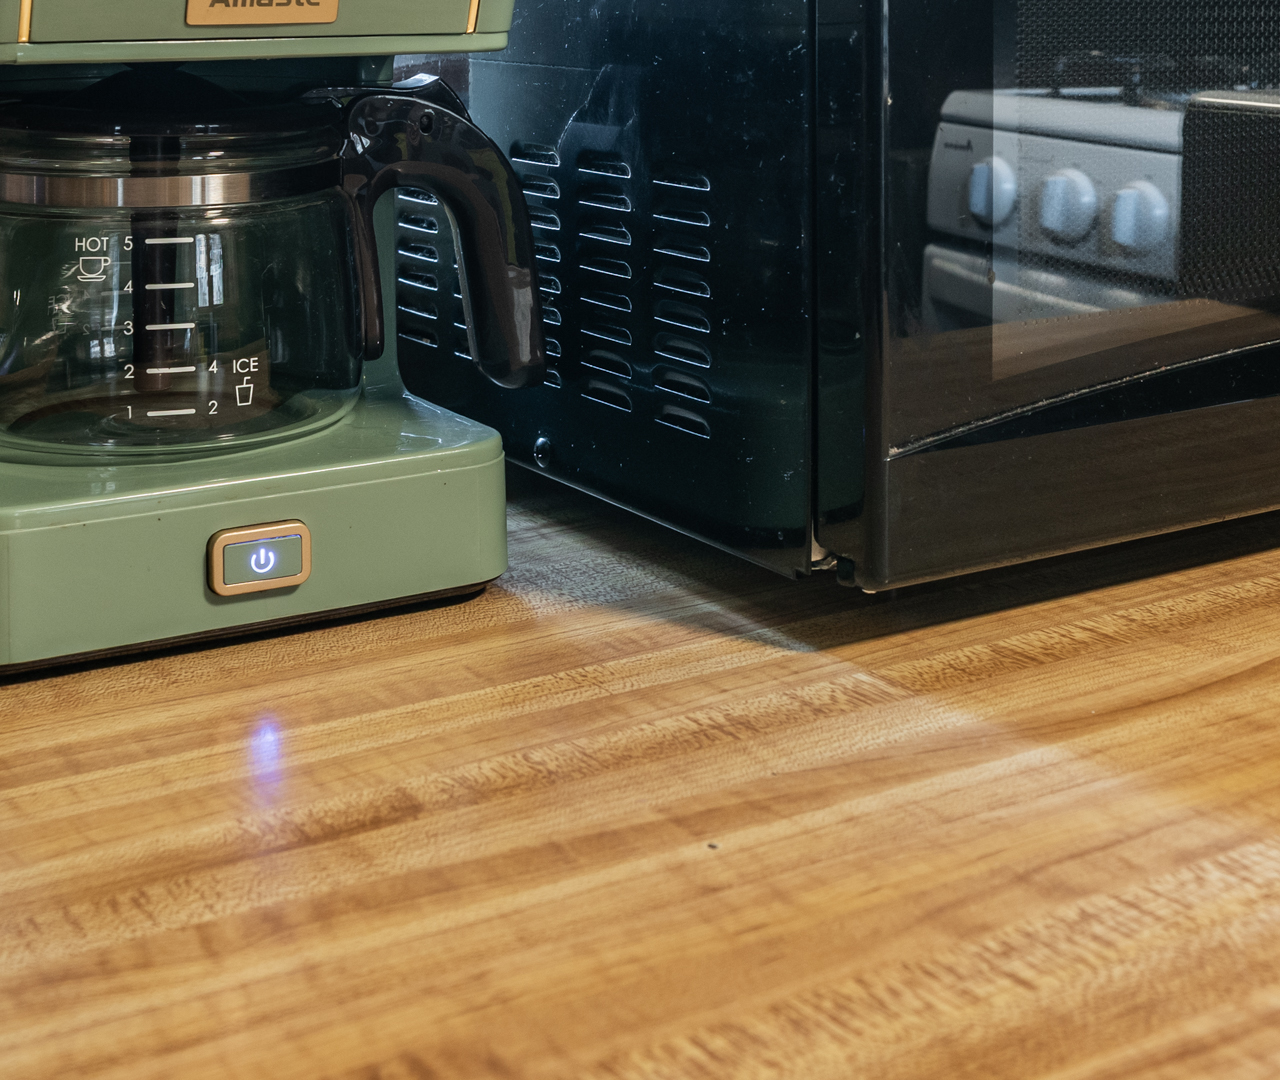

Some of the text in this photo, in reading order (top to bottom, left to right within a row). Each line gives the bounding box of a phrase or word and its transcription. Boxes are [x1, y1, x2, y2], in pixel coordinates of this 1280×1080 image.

[75, 237, 109, 251] HOT
[123, 236, 133, 250] 5
[123, 280, 133, 293] 4
[123, 321, 134, 335] 3
[124, 364, 134, 378] 2
[208, 360, 218, 373] 4
[233, 357, 259, 373] ICE
[126, 406, 132, 419] 1
[208, 401, 218, 415] 2
